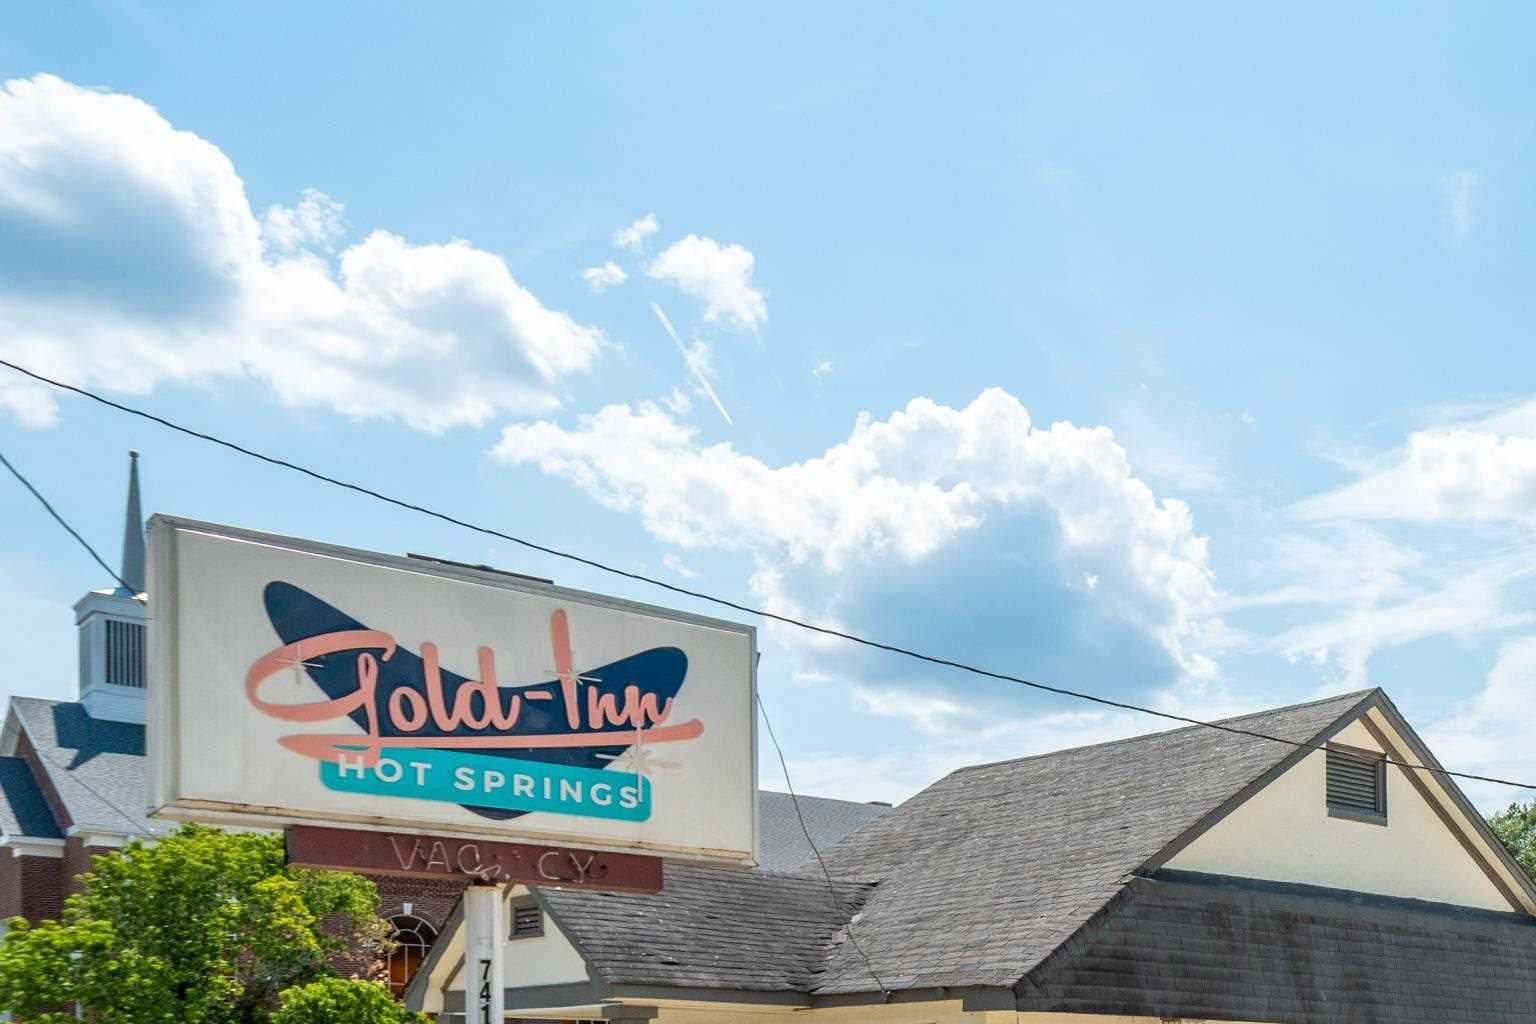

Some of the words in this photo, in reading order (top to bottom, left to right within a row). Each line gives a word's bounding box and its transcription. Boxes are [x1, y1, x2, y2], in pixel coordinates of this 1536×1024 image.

[245, 607, 696, 760] Gold-Inn
[337, 753, 433, 787] HOT
[454, 766, 640, 809] SPRINGS
[385, 835, 594, 884] VACCY
[479, 958, 492, 1024] 741
